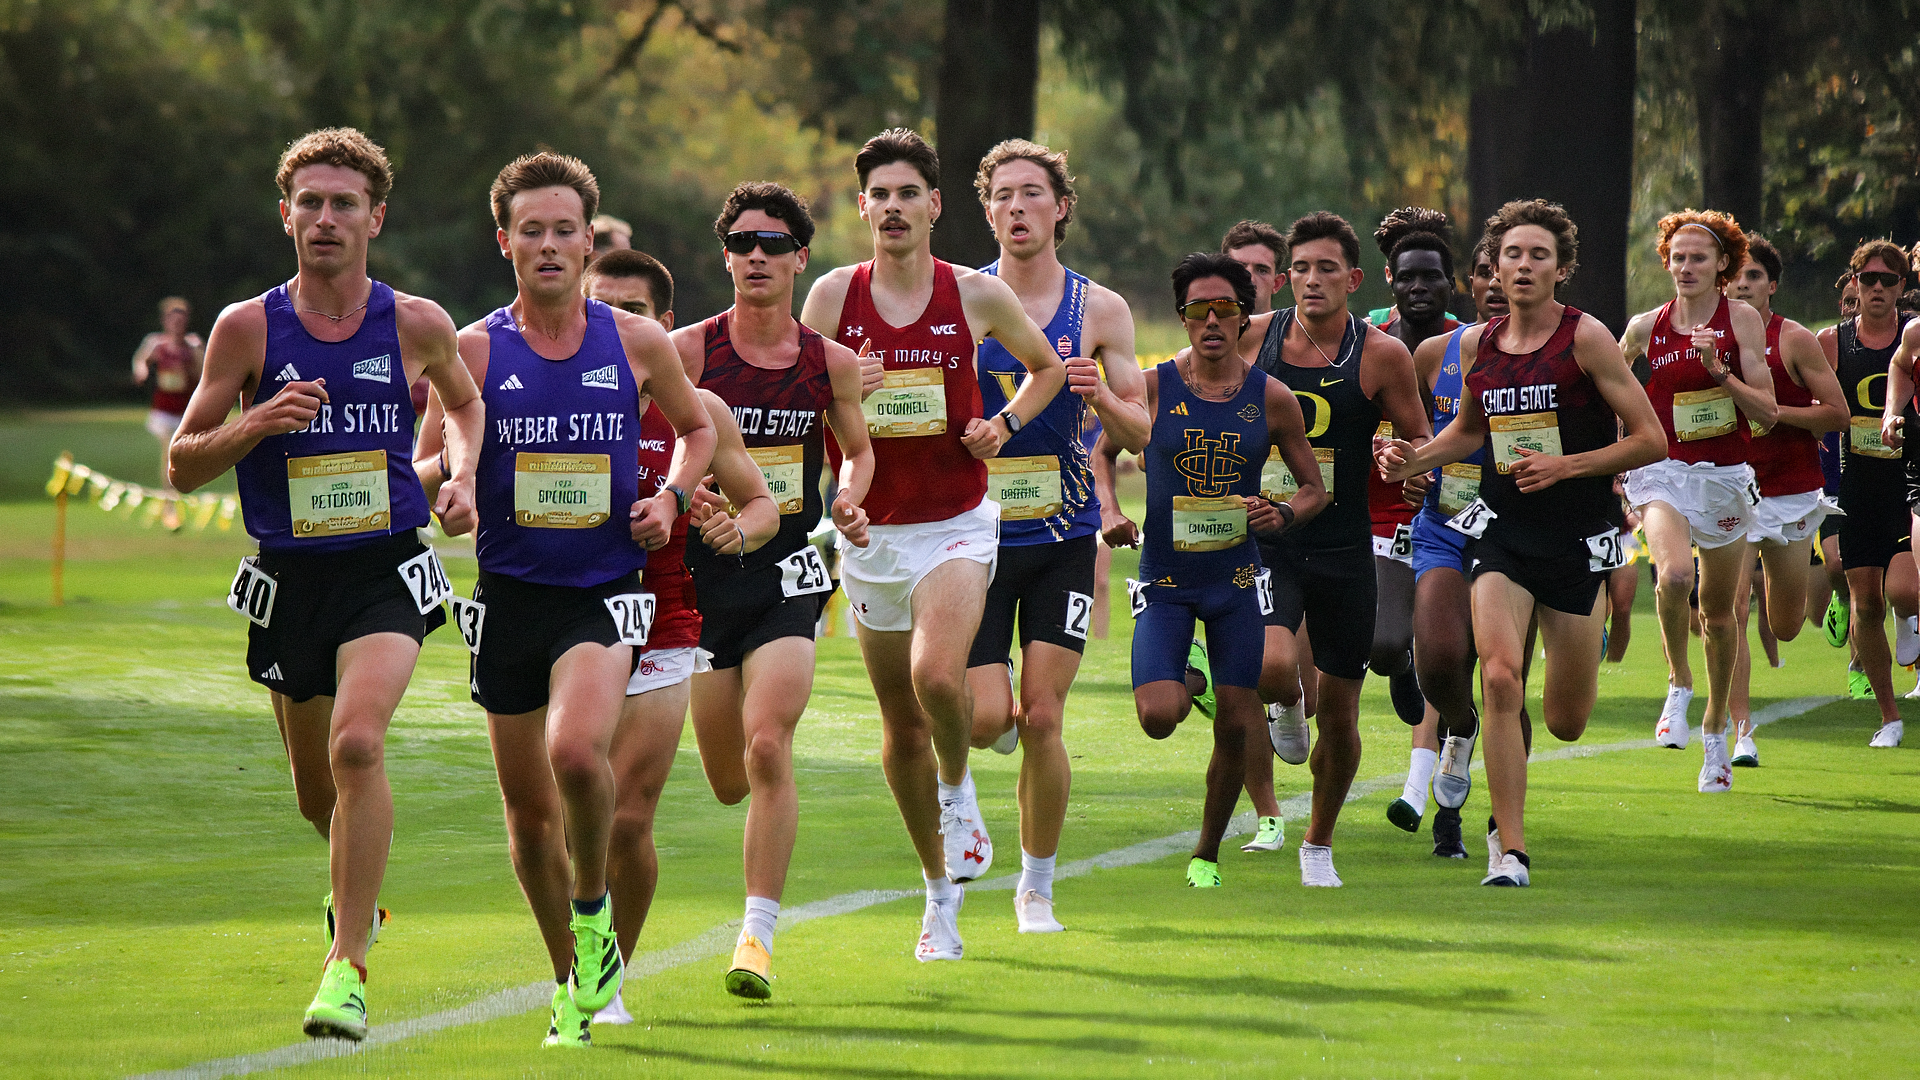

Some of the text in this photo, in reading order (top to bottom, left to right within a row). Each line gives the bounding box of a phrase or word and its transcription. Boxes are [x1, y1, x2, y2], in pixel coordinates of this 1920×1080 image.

[894, 349, 960, 369] MARY'S
[1482, 387, 1516, 414] CHICO
[1520, 383, 1559, 411] STATE
[344, 403, 399, 434] STATE
[497, 412, 624, 445] WEBER STATE
[764, 408, 816, 437] STATE
[790, 550, 825, 590] 25
[233, 568, 272, 621] 40
